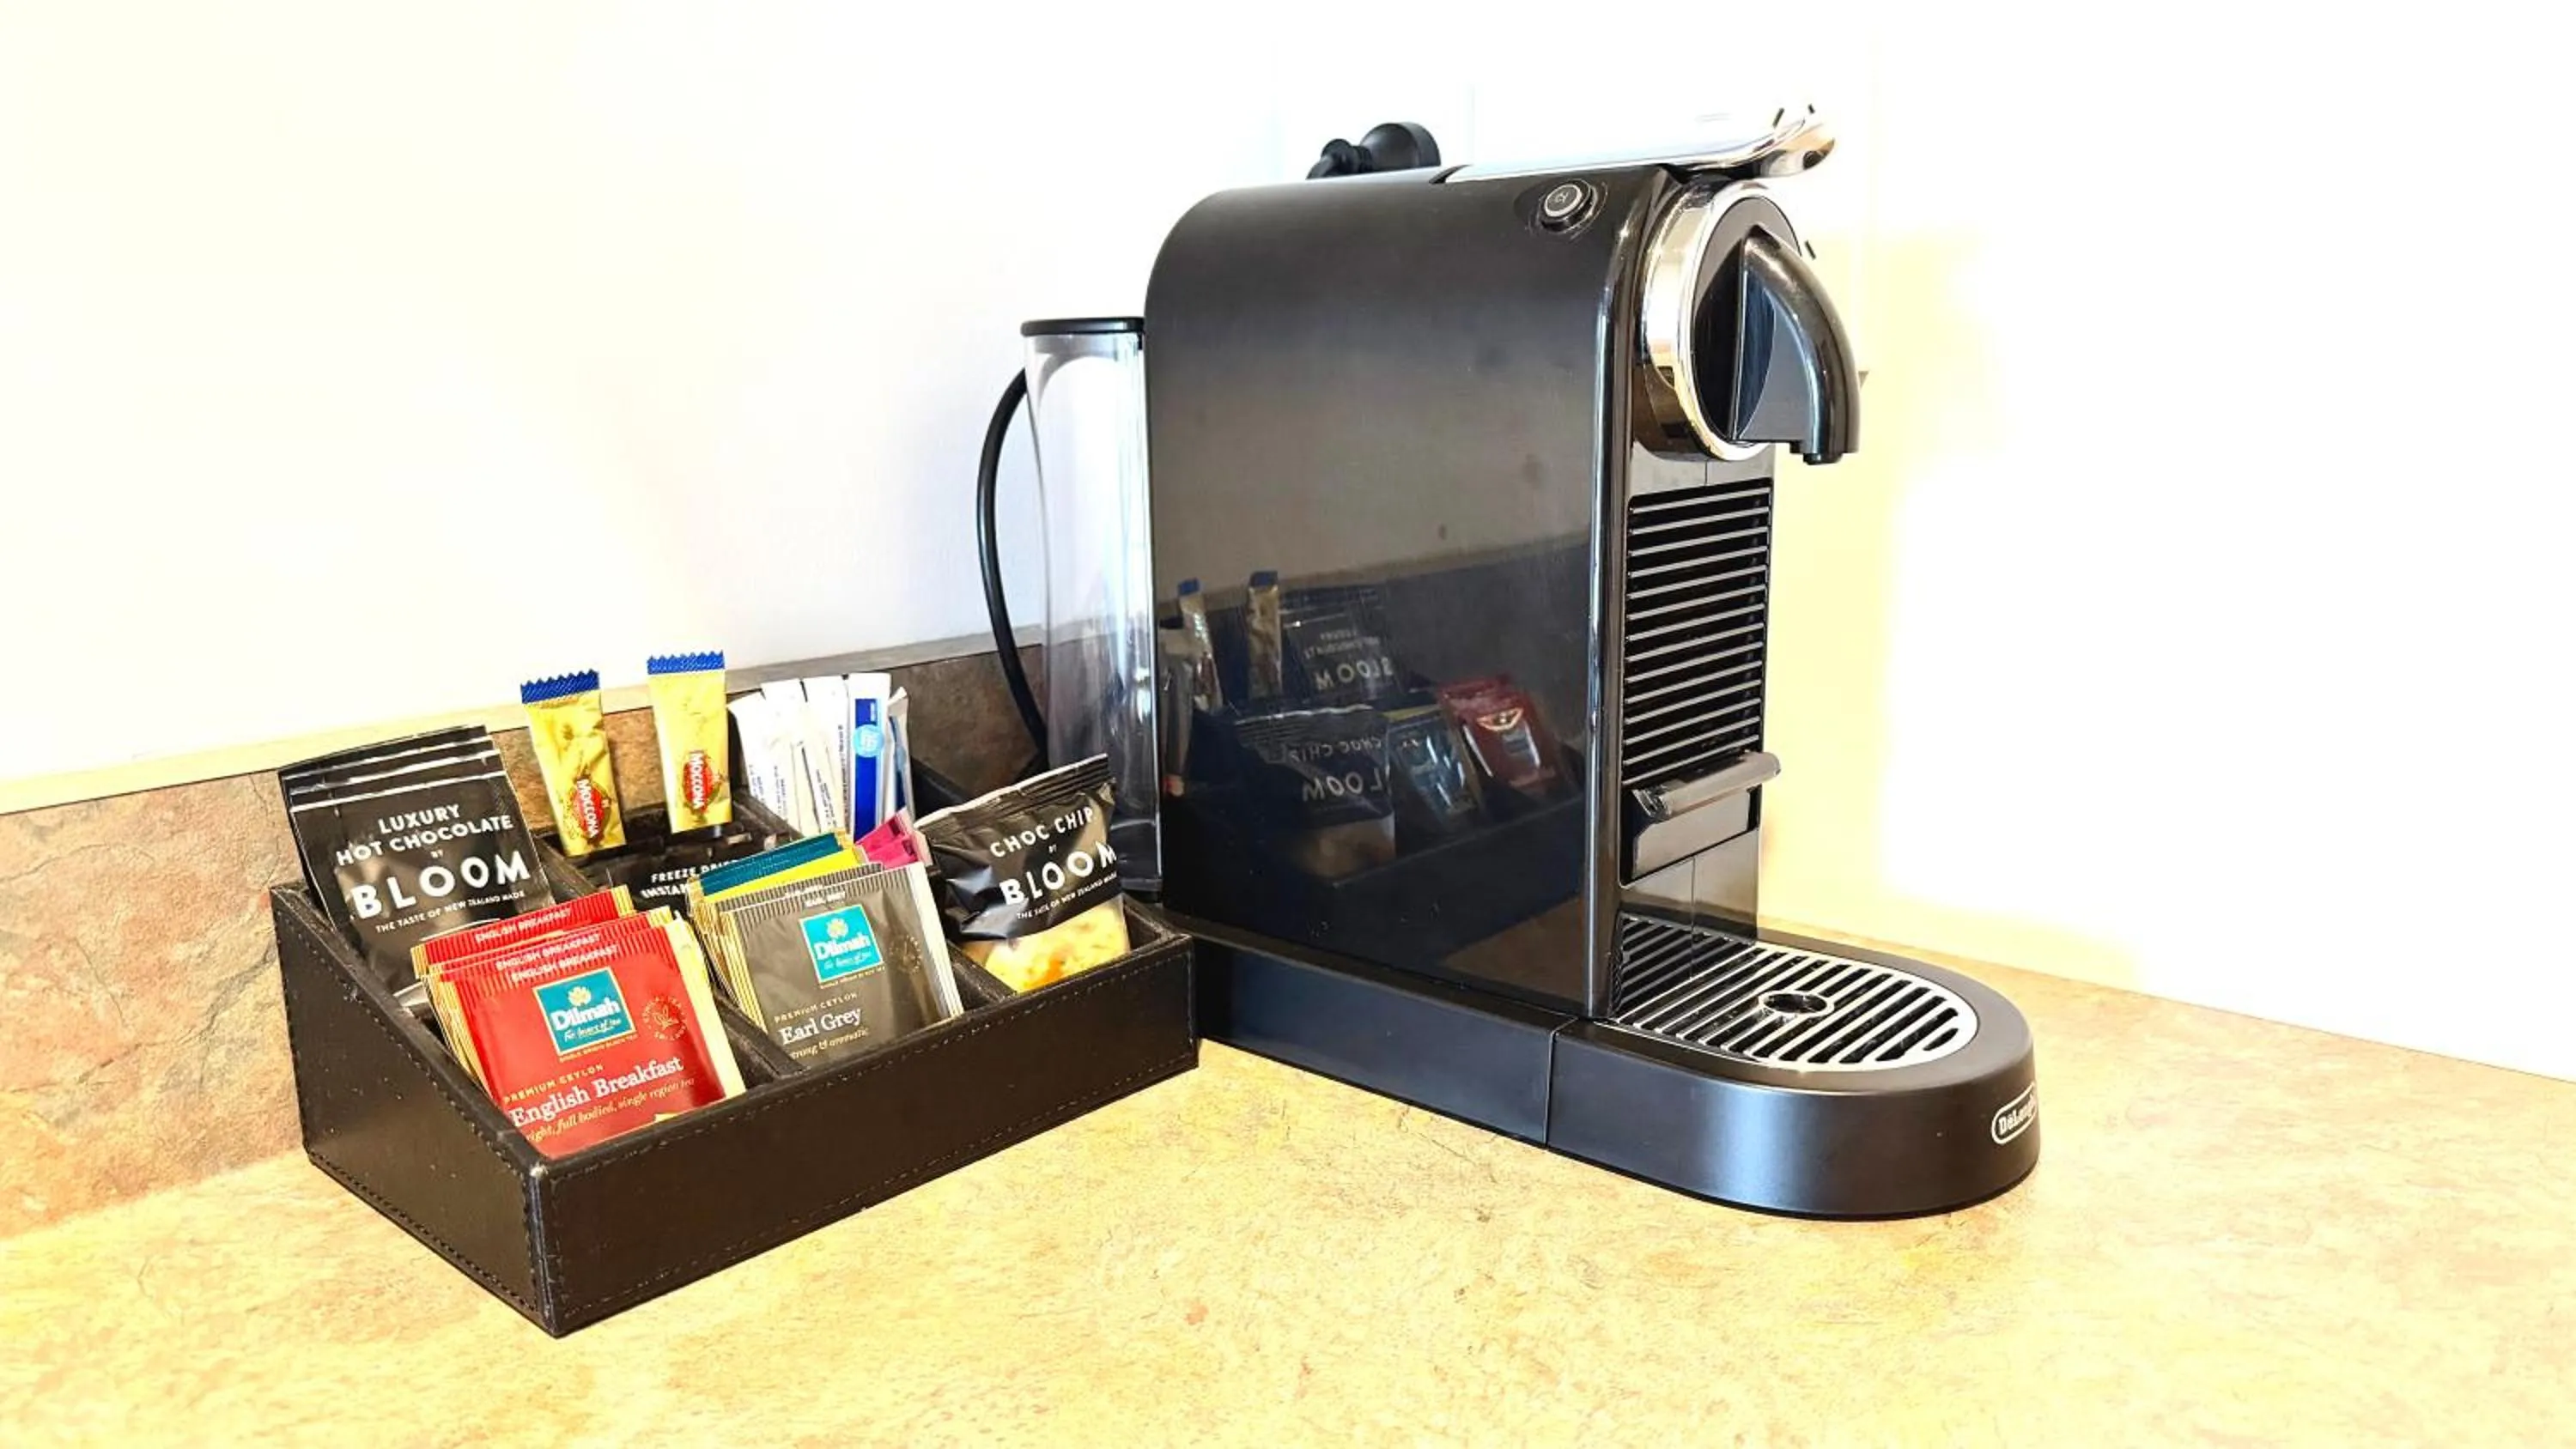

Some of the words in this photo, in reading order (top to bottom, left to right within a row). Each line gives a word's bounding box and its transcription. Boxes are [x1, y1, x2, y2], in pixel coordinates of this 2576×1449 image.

[690, 752, 705, 809] MOCCONA
[378, 803, 460, 834] LUXURY
[576, 779, 599, 839] MOCCONA
[336, 841, 384, 866] HOT
[390, 815, 514, 852] CHOCOLATE
[990, 825, 1050, 858] CHOC
[1054, 806, 1094, 834] CHIP
[350, 851, 531, 919] BLOOM
[651, 867, 696, 883] FREEZE
[999, 840, 1117, 905] BLOOM
[376, 921, 395, 933] THE
[398, 914, 426, 927] TASTE
[428, 908, 442, 918] OF
[444, 900, 467, 913] NEW
[468, 895, 501, 907] ZEALAND
[502, 890, 526, 901] MADE
[814, 931, 872, 961] Dilmah
[550, 997, 622, 1030] Dilmah
[774, 1003, 818, 1023] PREMIUM
[820, 992, 858, 1009] CEYLON
[777, 1017, 820, 1045] Earl
[821, 1008, 861, 1031] Grey
[503, 1079, 556, 1104] PREMIUM
[559, 1064, 604, 1084] CEYLON
[508, 1085, 592, 1127] English
[591, 1057, 683, 1098] Breakfast
[556, 1114, 578, 1135] full
